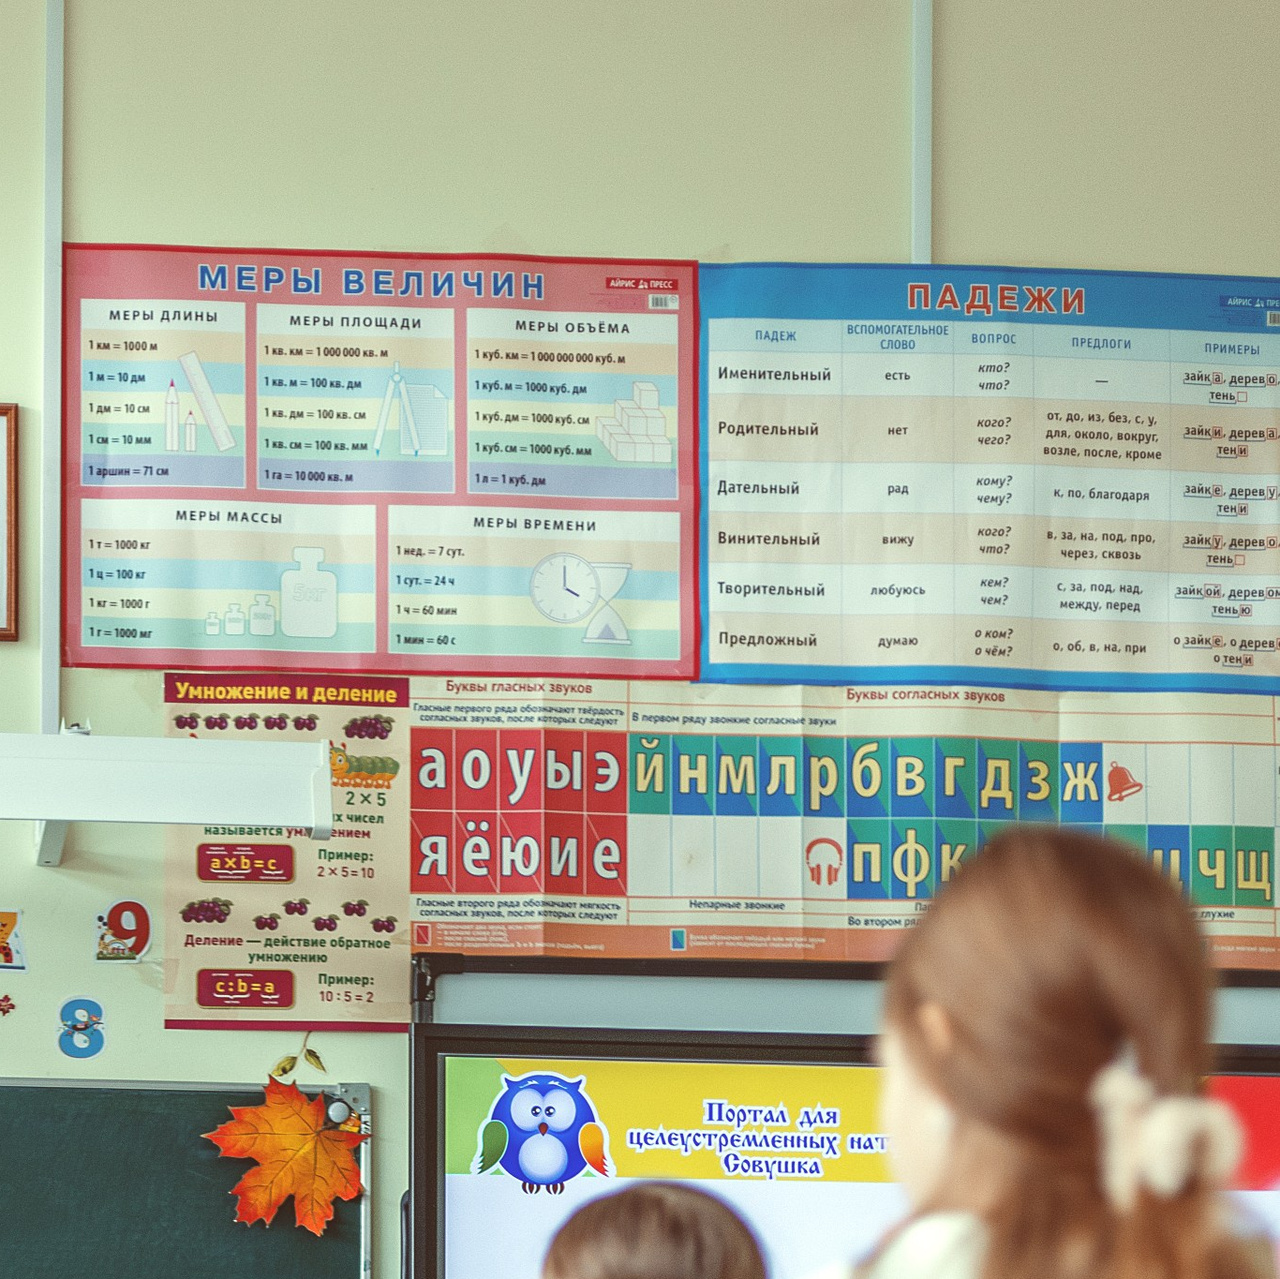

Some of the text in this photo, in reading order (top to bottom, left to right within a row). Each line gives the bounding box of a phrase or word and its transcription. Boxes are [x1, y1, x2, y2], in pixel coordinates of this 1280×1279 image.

[198, 263, 545, 299] МЕРЫ ВЕЛИЧИН
[609, 280, 673, 289] АЙРИС ПРЕСС
[907, 283, 1086, 316] ПАДЕЖИ
[1227, 298, 1253, 306] АЙРИС
[109, 310, 217, 322] МЕРЫ ДЛИНЫ
[290, 315, 421, 330] МЕРЫ ПЛОЩАДИ
[515, 320, 630, 334] МЕРЫ ОБЪЁМА
[847, 324, 949, 336] ВСПОМОГАТЕЛЬНОЕ
[755, 330, 796, 343] ПАДЕЖ
[880, 339, 916, 350] СЛОВО
[971, 333, 1016, 345] ВОПРОС
[1071, 337, 1131, 350] ПРЕДЛОГИ
[1204, 342, 1260, 355] ПРИМЕРЫ
[718, 366, 831, 381] Именительный
[978, 361, 1011, 373] кто?
[884, 372, 911, 381] есть
[978, 379, 1011, 391] что?
[718, 421, 819, 436] Родительный
[976, 416, 1012, 428] кого?
[888, 427, 908, 435] нет
[977, 434, 1012, 445] чего?
[1043, 446, 1162, 462] возле, после, кроме
[717, 480, 799, 496] Дательный
[976, 475, 1013, 489] кому?
[887, 485, 909, 496] рад
[977, 492, 1013, 507] чему?
[176, 510, 282, 524] МЕРЫ МАССЫ
[473, 517, 596, 531] МЕРЫ ВРЕМЕНИ
[718, 531, 820, 546] Винительный
[882, 536, 914, 547] вижу
[718, 581, 825, 598] Творительный
[870, 584, 926, 598] любуюсь
[719, 631, 817, 648] Предложный
[878, 637, 919, 649] думаю
[175, 681, 398, 704] Умножение и деление
[446, 679, 592, 696] Буквы гласных звуков
[846, 688, 1006, 704] Буквы согласных звуков
[632, 712, 837, 728] В первом ряду звонкие согласные звуки
[418, 747, 447, 790] а
[461, 748, 492, 792] о
[545, 748, 583, 791] ы
[594, 748, 621, 793] э
[635, 737, 665, 794] й
[851, 740, 883, 799] б
[504, 748, 537, 805] у
[678, 753, 709, 796] н
[718, 754, 757, 796] м
[765, 754, 797, 796] л
[895, 755, 927, 798] в
[943, 756, 966, 797] г
[1026, 760, 1052, 802] з
[1062, 761, 1100, 802] ж
[809, 755, 840, 812] р
[980, 758, 1014, 810] д
[204, 826, 283, 836] называется
[318, 848, 373, 863] Пример:
[418, 835, 449, 877] я
[461, 820, 492, 882] ё
[500, 836, 542, 878] ю
[550, 836, 579, 878] и
[593, 835, 621, 880] е
[852, 842, 883, 883] п
[892, 828, 932, 898] ф
[1198, 848, 1227, 890] ч
[1236, 849, 1272, 901] щ
[689, 899, 786, 911] Непарные звонкие
[107, 900, 151, 958] 9
[184, 934, 391, 950] Деление действие обратное
[248, 953, 328, 964] умножению
[318, 973, 374, 988] Пример:
[58, 998, 105, 1058] 8
[704, 1101, 839, 1129] Портал для
[628, 1128, 838, 1157] целеустремленных
[722, 1153, 822, 1180] Совушка
